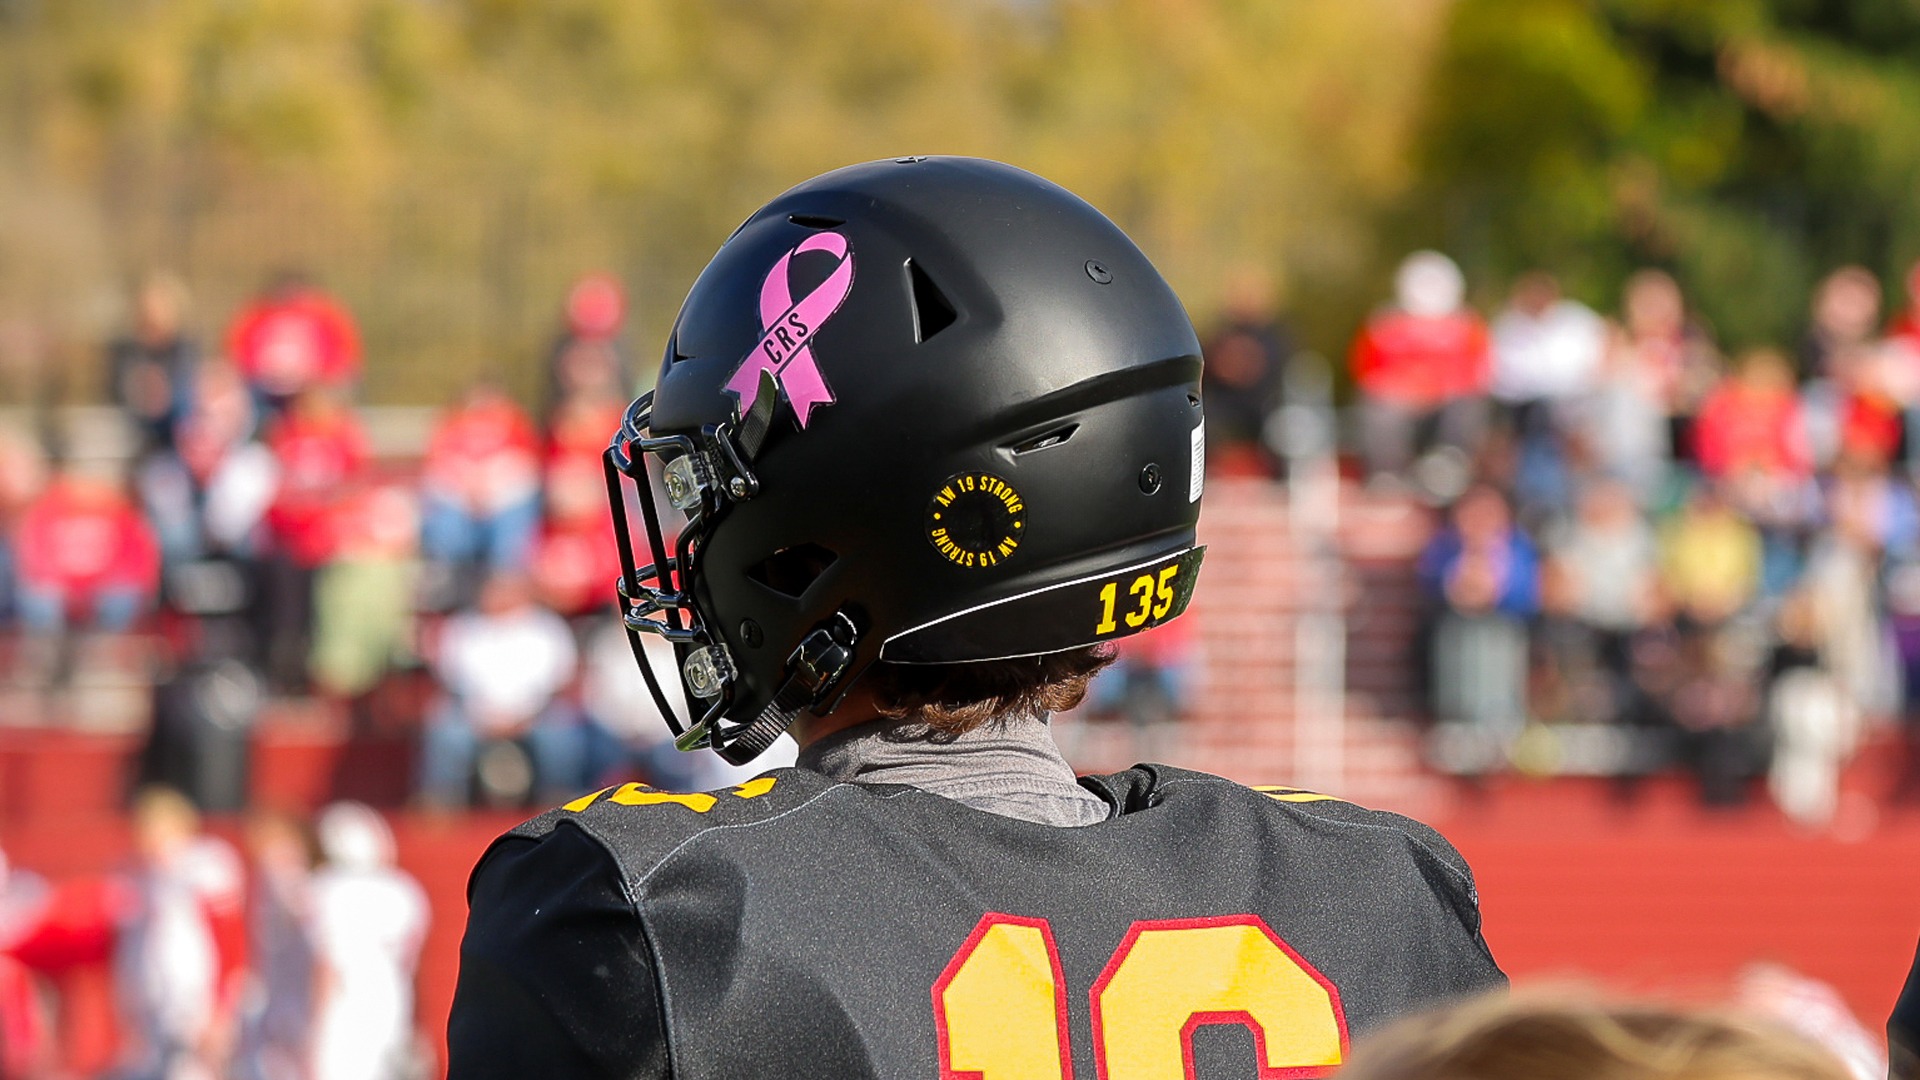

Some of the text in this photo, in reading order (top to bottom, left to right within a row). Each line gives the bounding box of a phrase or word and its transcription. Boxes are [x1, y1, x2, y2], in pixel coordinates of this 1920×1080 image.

[763, 312, 808, 365] CRS
[936, 475, 1023, 514] AW 19 STRONG
[931, 527, 1018, 567] AW 19 STRONG
[1096, 564, 1179, 635] 135
